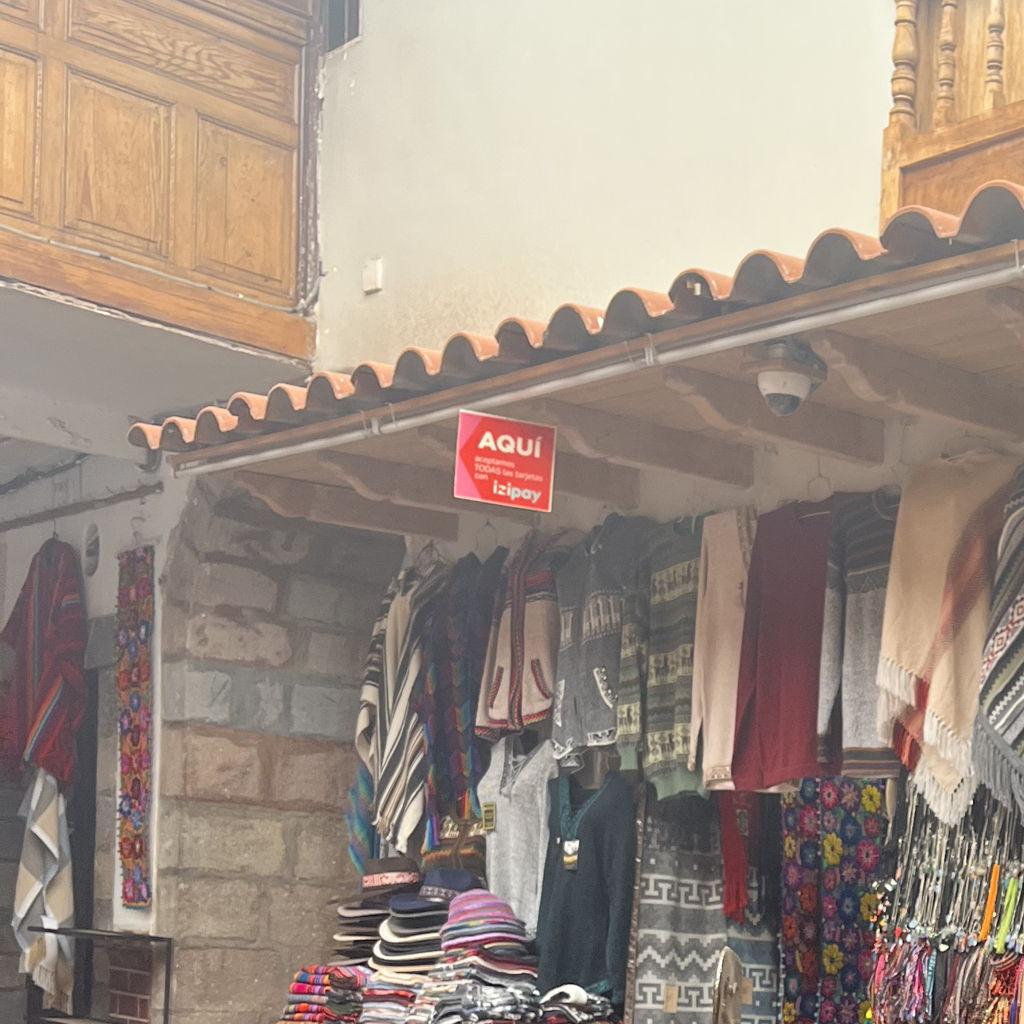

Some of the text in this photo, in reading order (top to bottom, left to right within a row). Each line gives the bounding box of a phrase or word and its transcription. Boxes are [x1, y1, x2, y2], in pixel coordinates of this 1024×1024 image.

[478, 431, 543, 458] AQUÍ
[475, 457, 515, 468] aceptamos
[475, 464, 542, 481] TODAS las tarjetas
[493, 480, 541, 503] izipay
